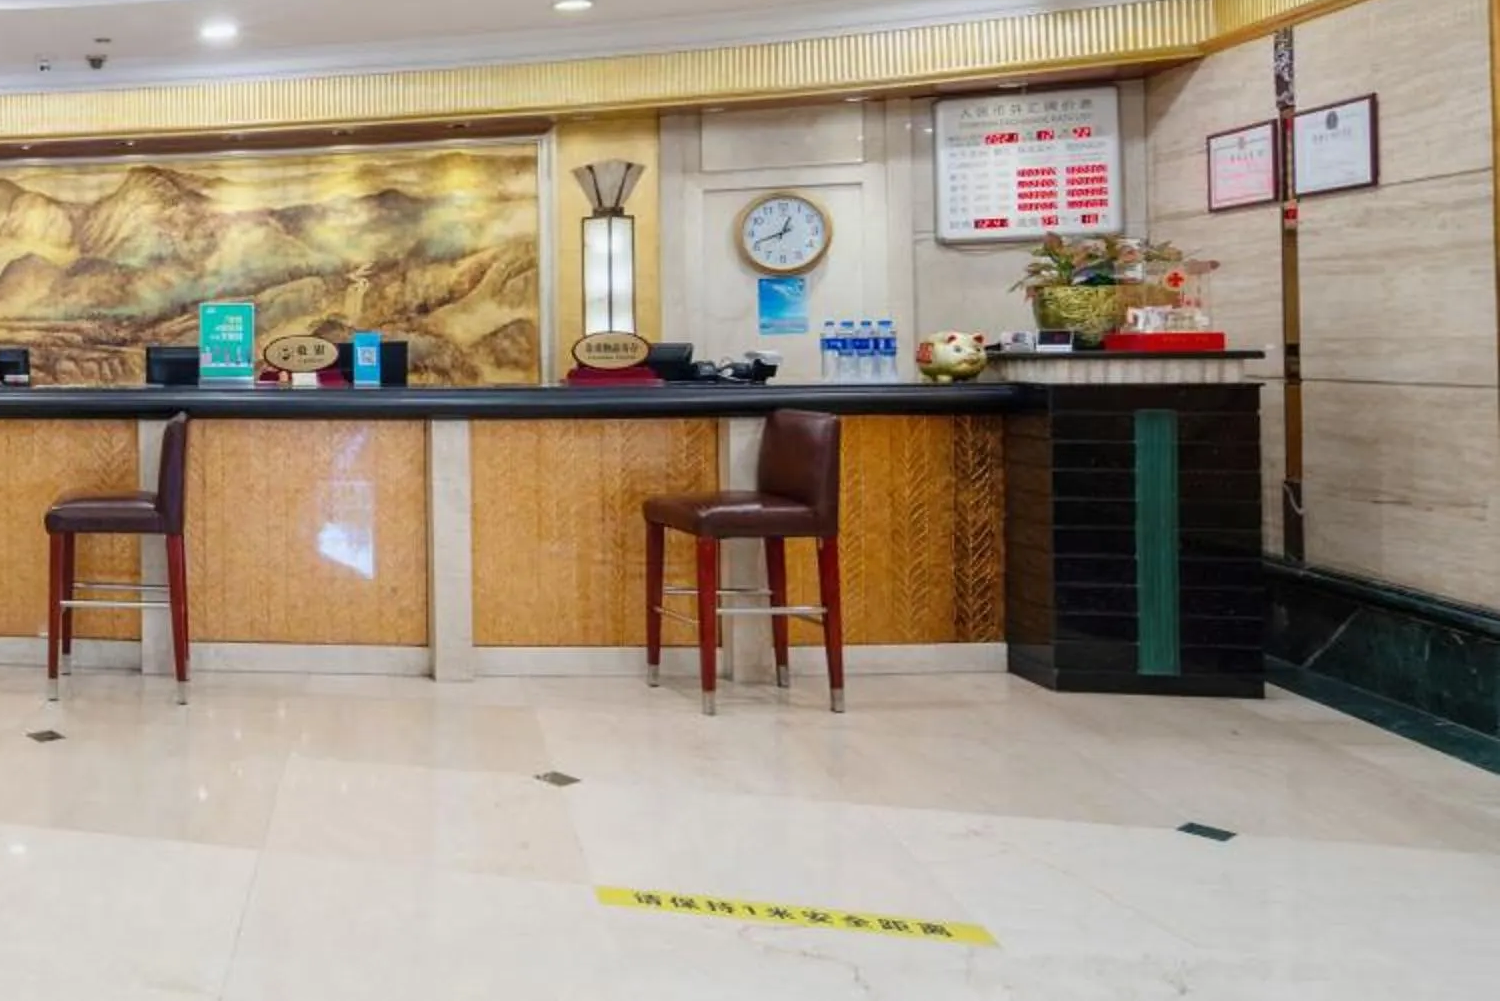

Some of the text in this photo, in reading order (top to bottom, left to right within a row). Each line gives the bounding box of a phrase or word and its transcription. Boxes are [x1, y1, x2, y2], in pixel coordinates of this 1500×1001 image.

[634, 891, 953, 937] 请保持1米安全距离
